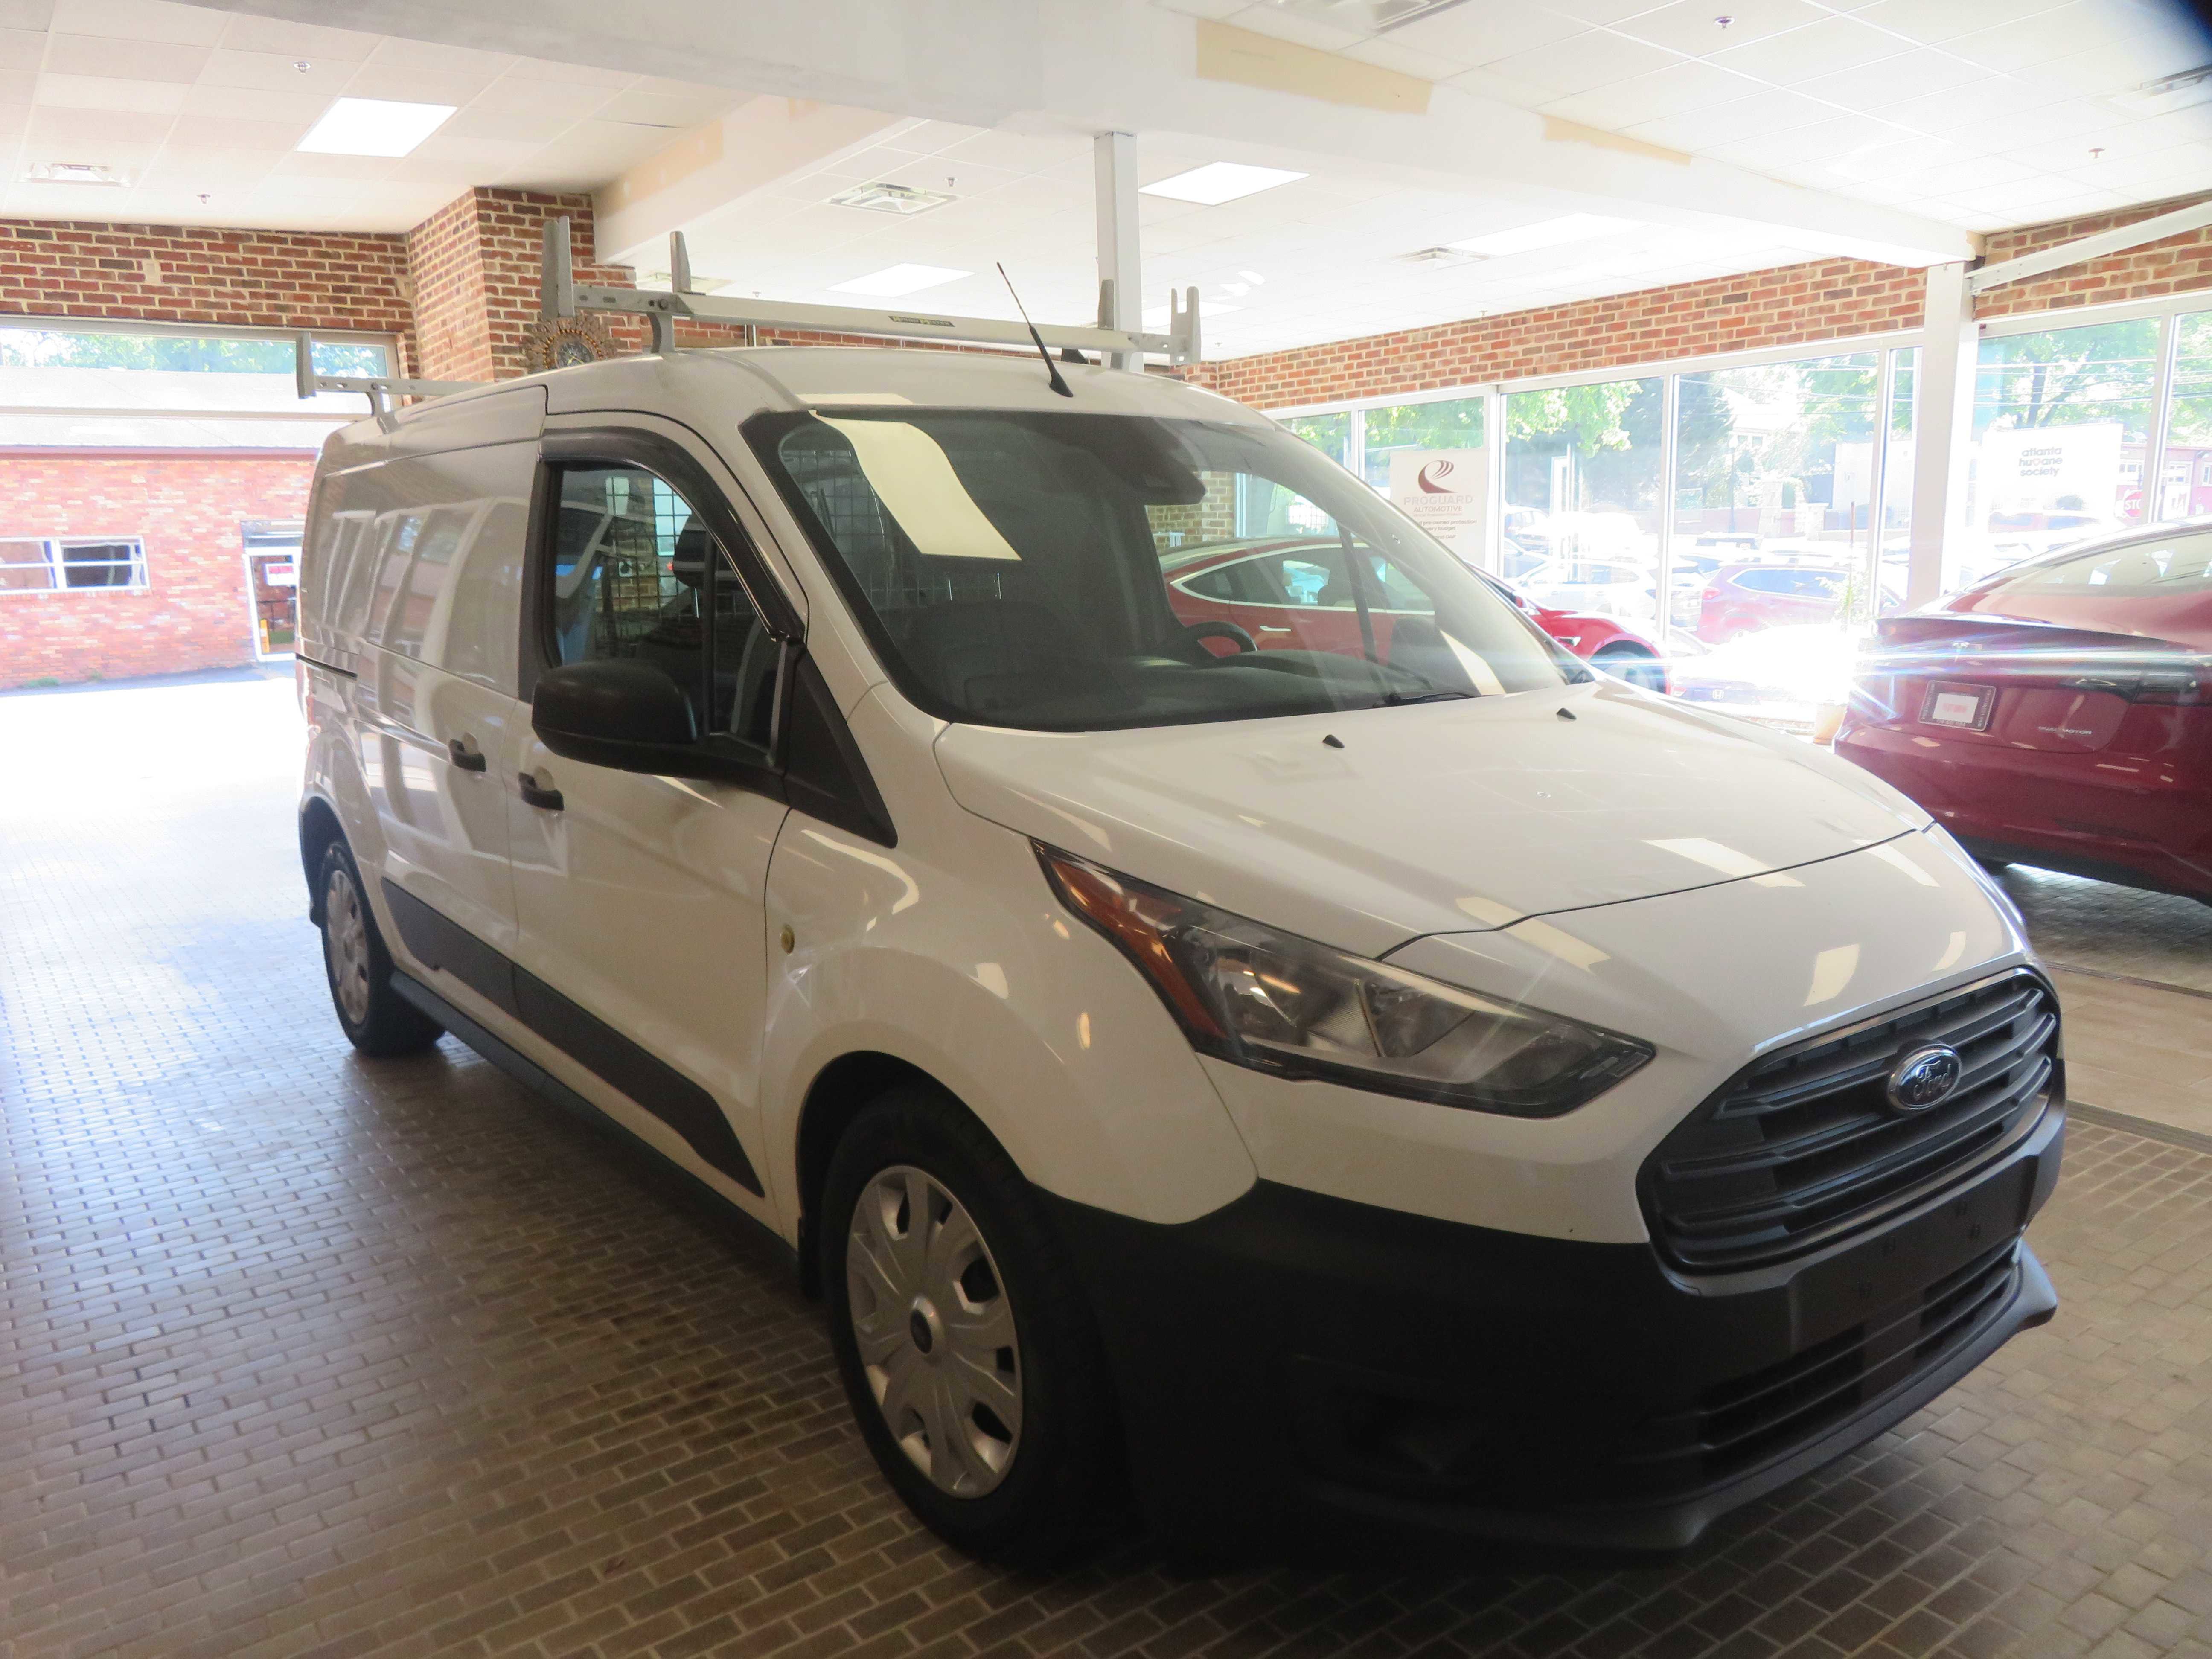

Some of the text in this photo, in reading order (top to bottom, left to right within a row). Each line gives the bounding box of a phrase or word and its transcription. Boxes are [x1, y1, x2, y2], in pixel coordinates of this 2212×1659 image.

[2020, 467, 2060, 477] society
[1404, 495, 1473, 505] PROGUARD
[2125, 499, 2142, 510] STO
[1913, 1060, 1952, 1101] Ford
